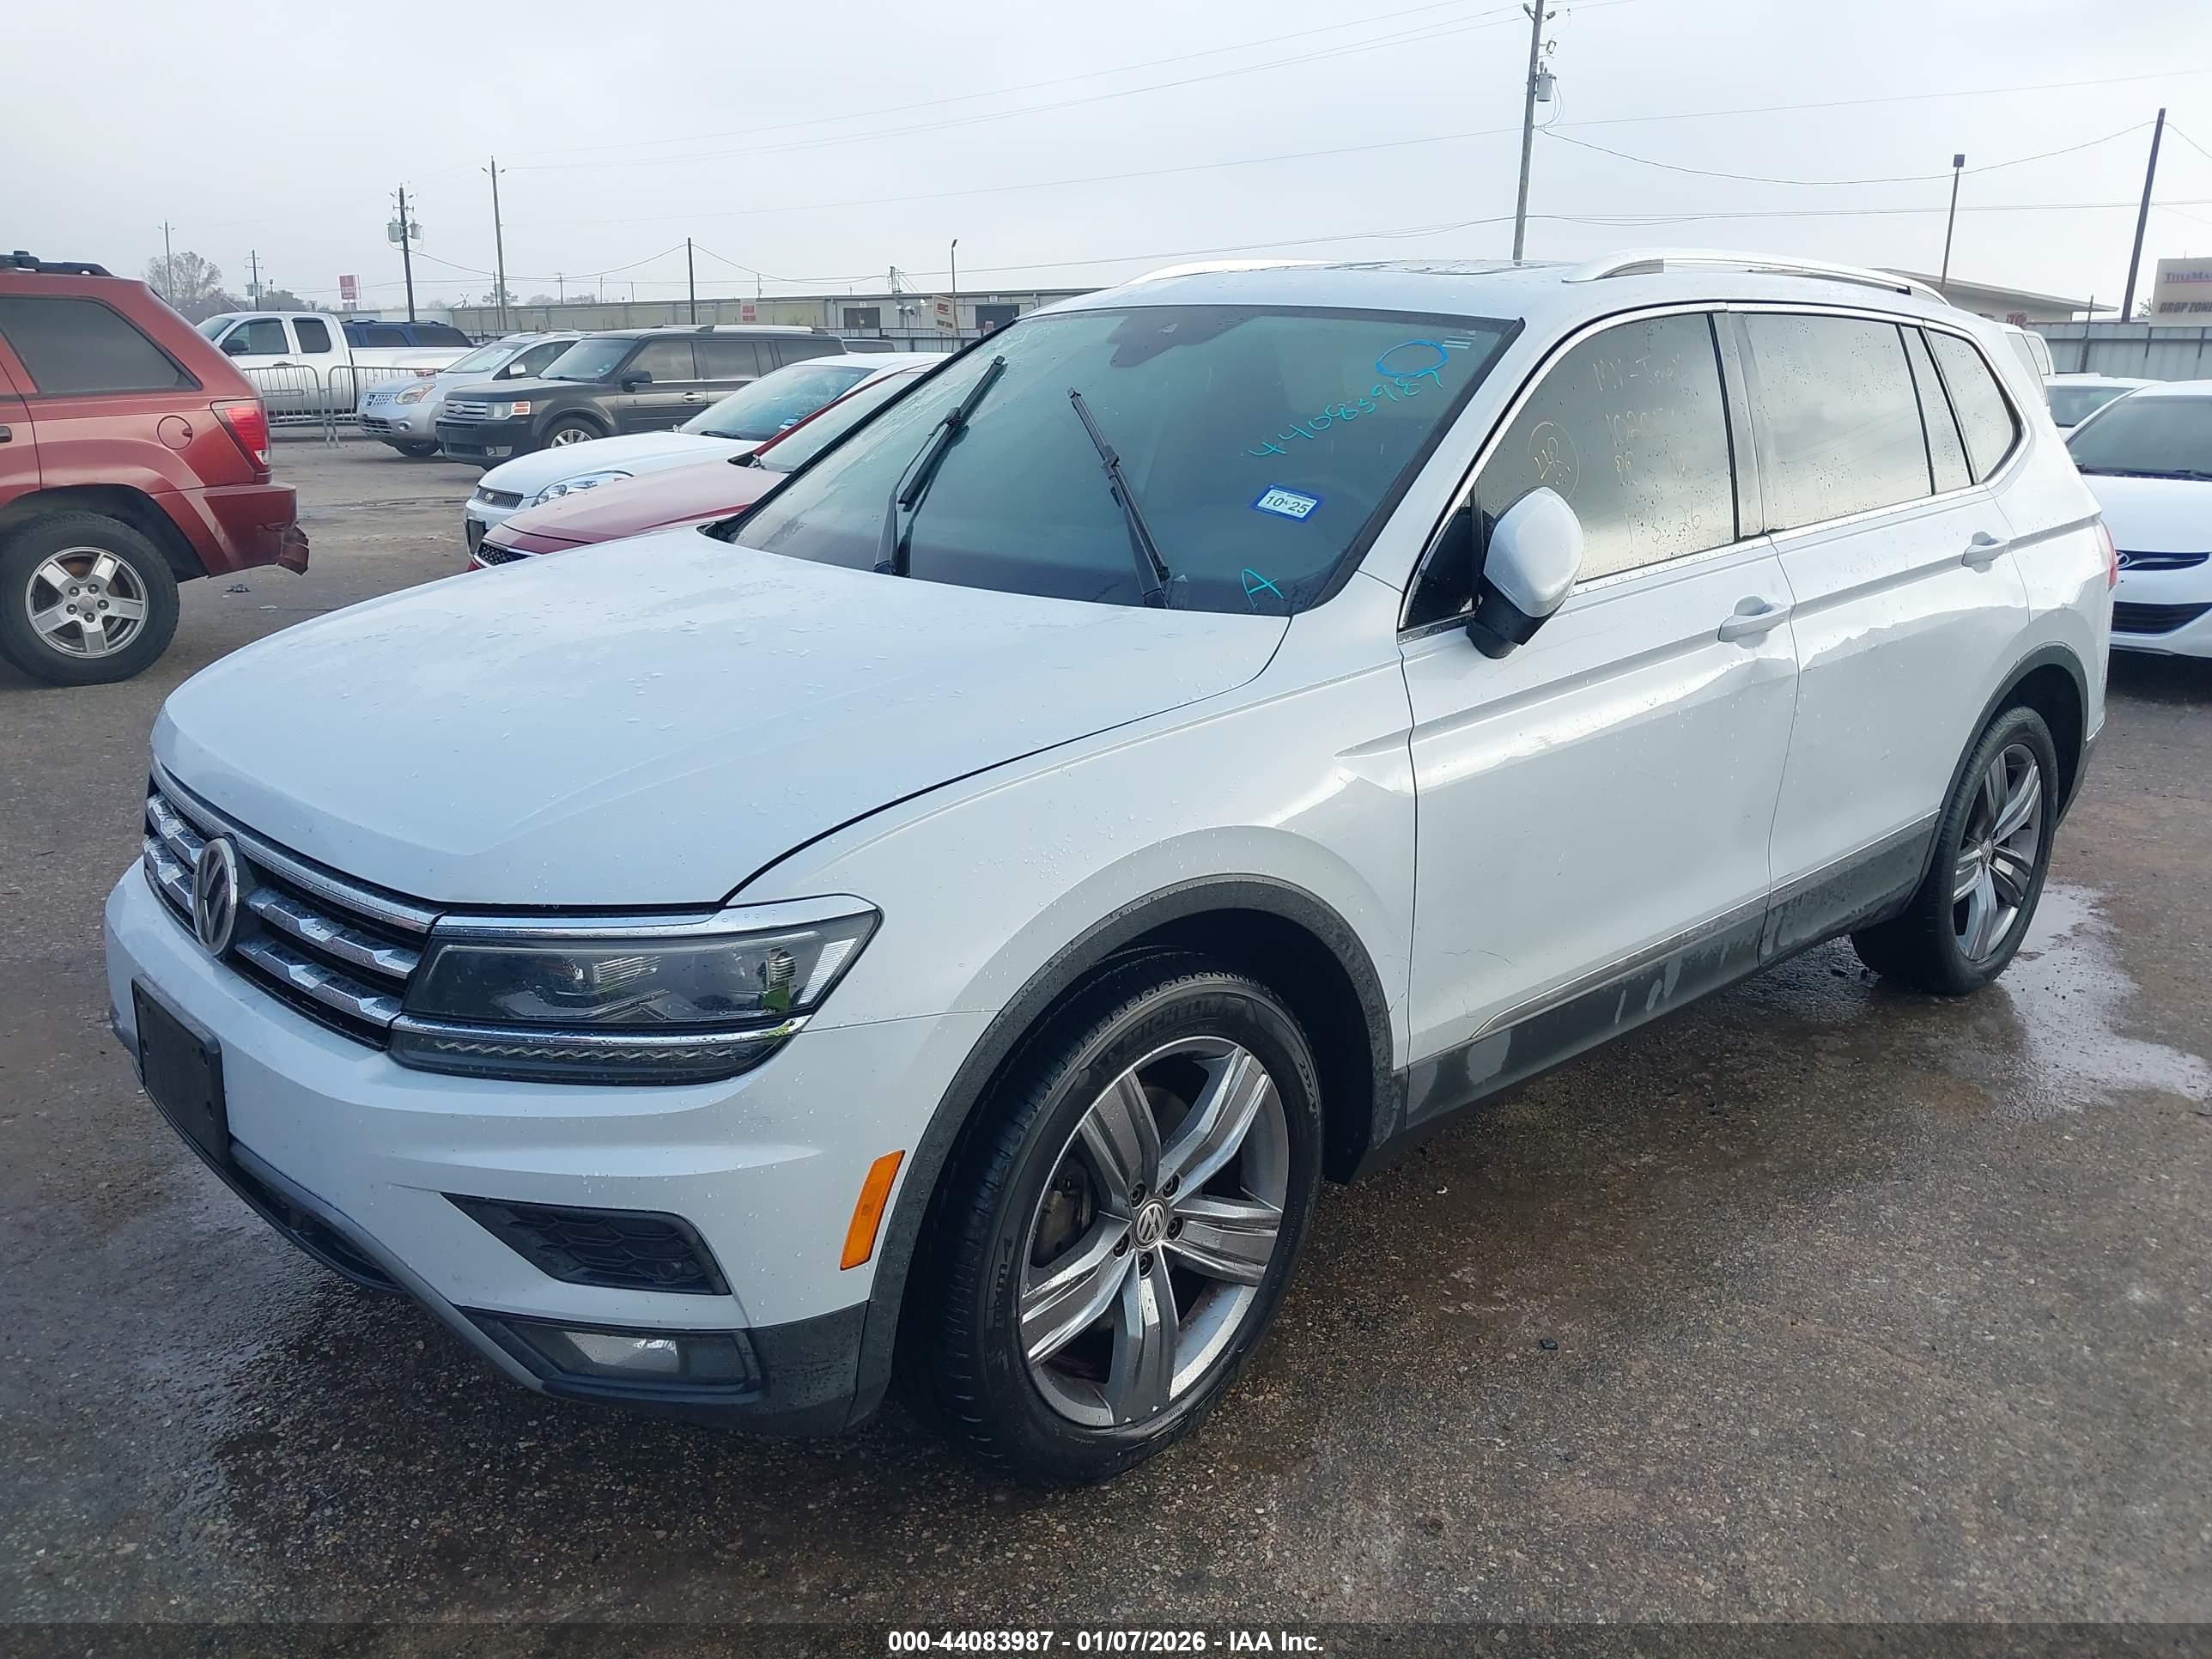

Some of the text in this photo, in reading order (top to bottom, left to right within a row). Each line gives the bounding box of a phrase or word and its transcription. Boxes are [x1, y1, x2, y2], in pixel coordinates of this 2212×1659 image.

[2159, 301, 2188, 313] DROP
[1266, 495, 1285, 507] 10
[1287, 501, 1310, 514] 25
[1241, 568, 1284, 609] A
